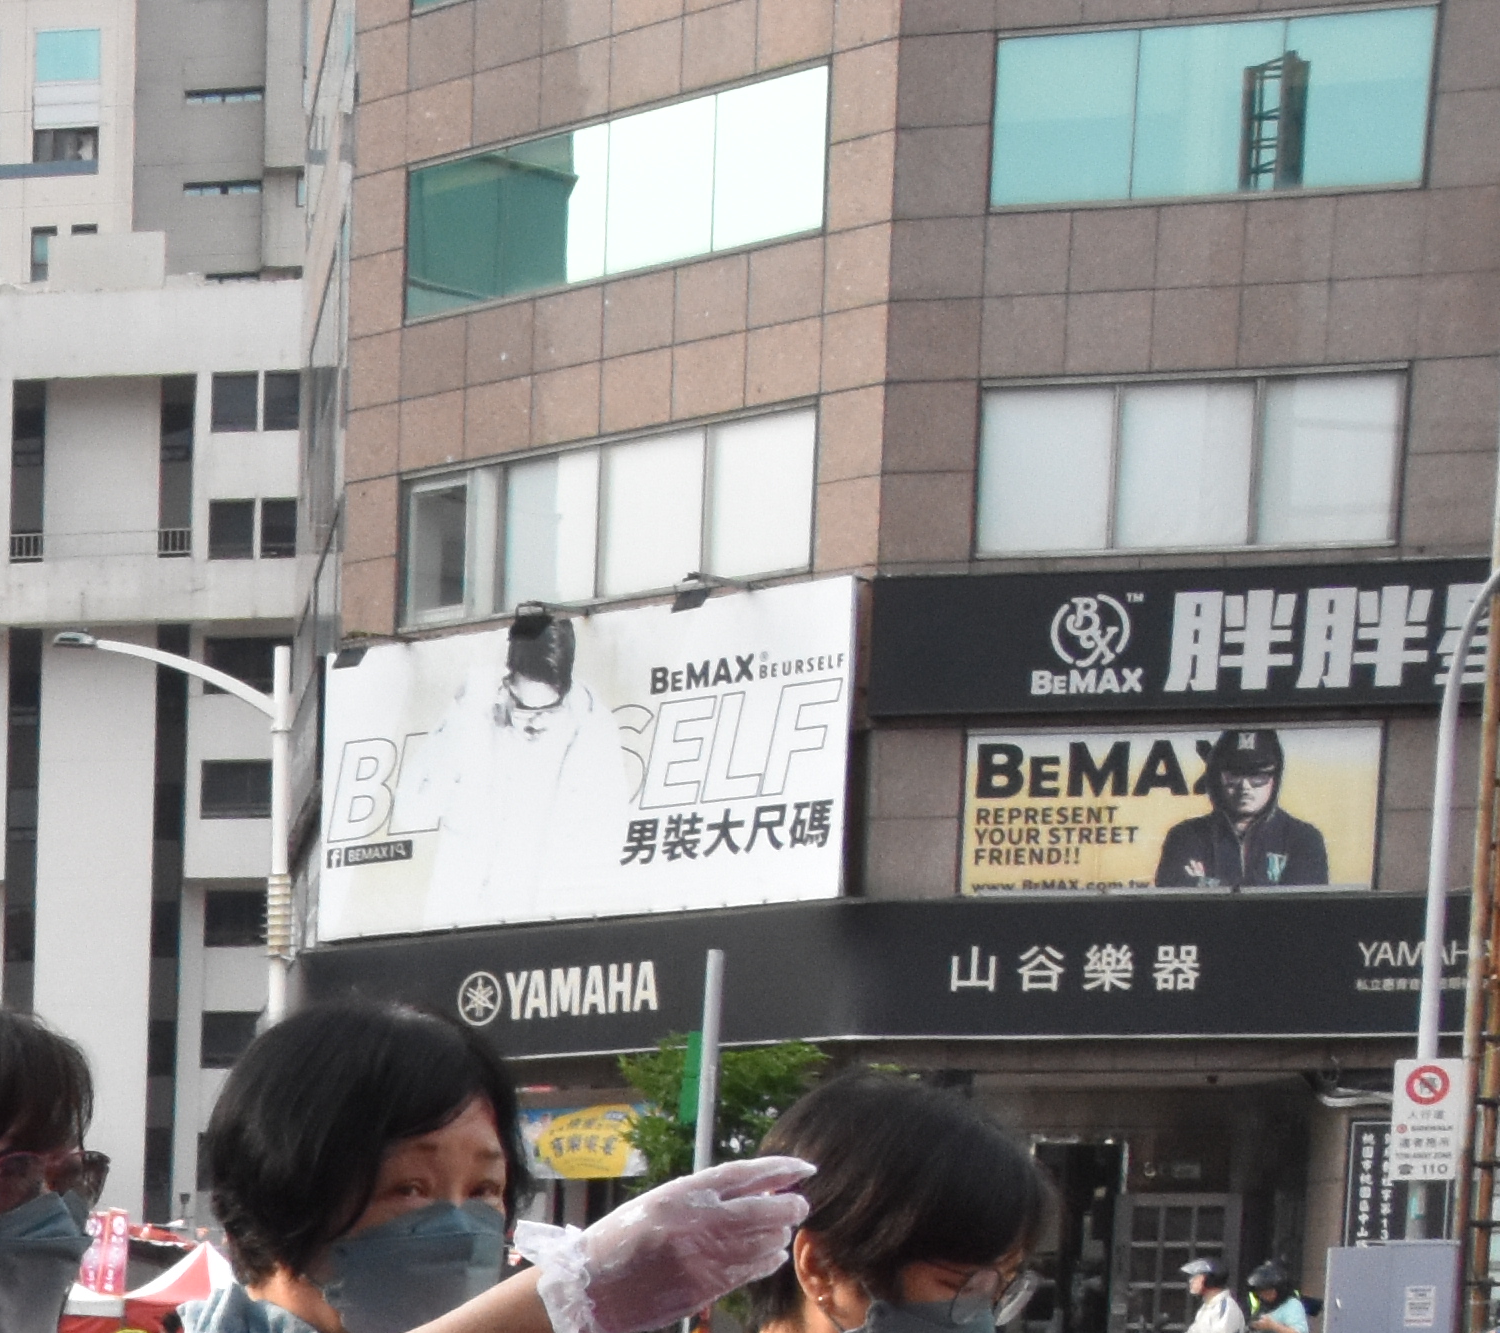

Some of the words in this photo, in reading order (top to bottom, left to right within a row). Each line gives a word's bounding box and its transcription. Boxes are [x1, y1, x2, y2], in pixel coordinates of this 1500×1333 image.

[976, 805, 1118, 825] REPRESENT
[620, 800, 834, 866] 男裝大尺碼
[975, 826, 1040, 846] YOUR
[1048, 825, 1139, 845] STREET
[974, 846, 1081, 866] FRIEND!!
[950, 944, 1199, 992] 山谷樂器
[505, 961, 658, 1020] YAMAHA
[1422, 1164, 1447, 1174] 110
